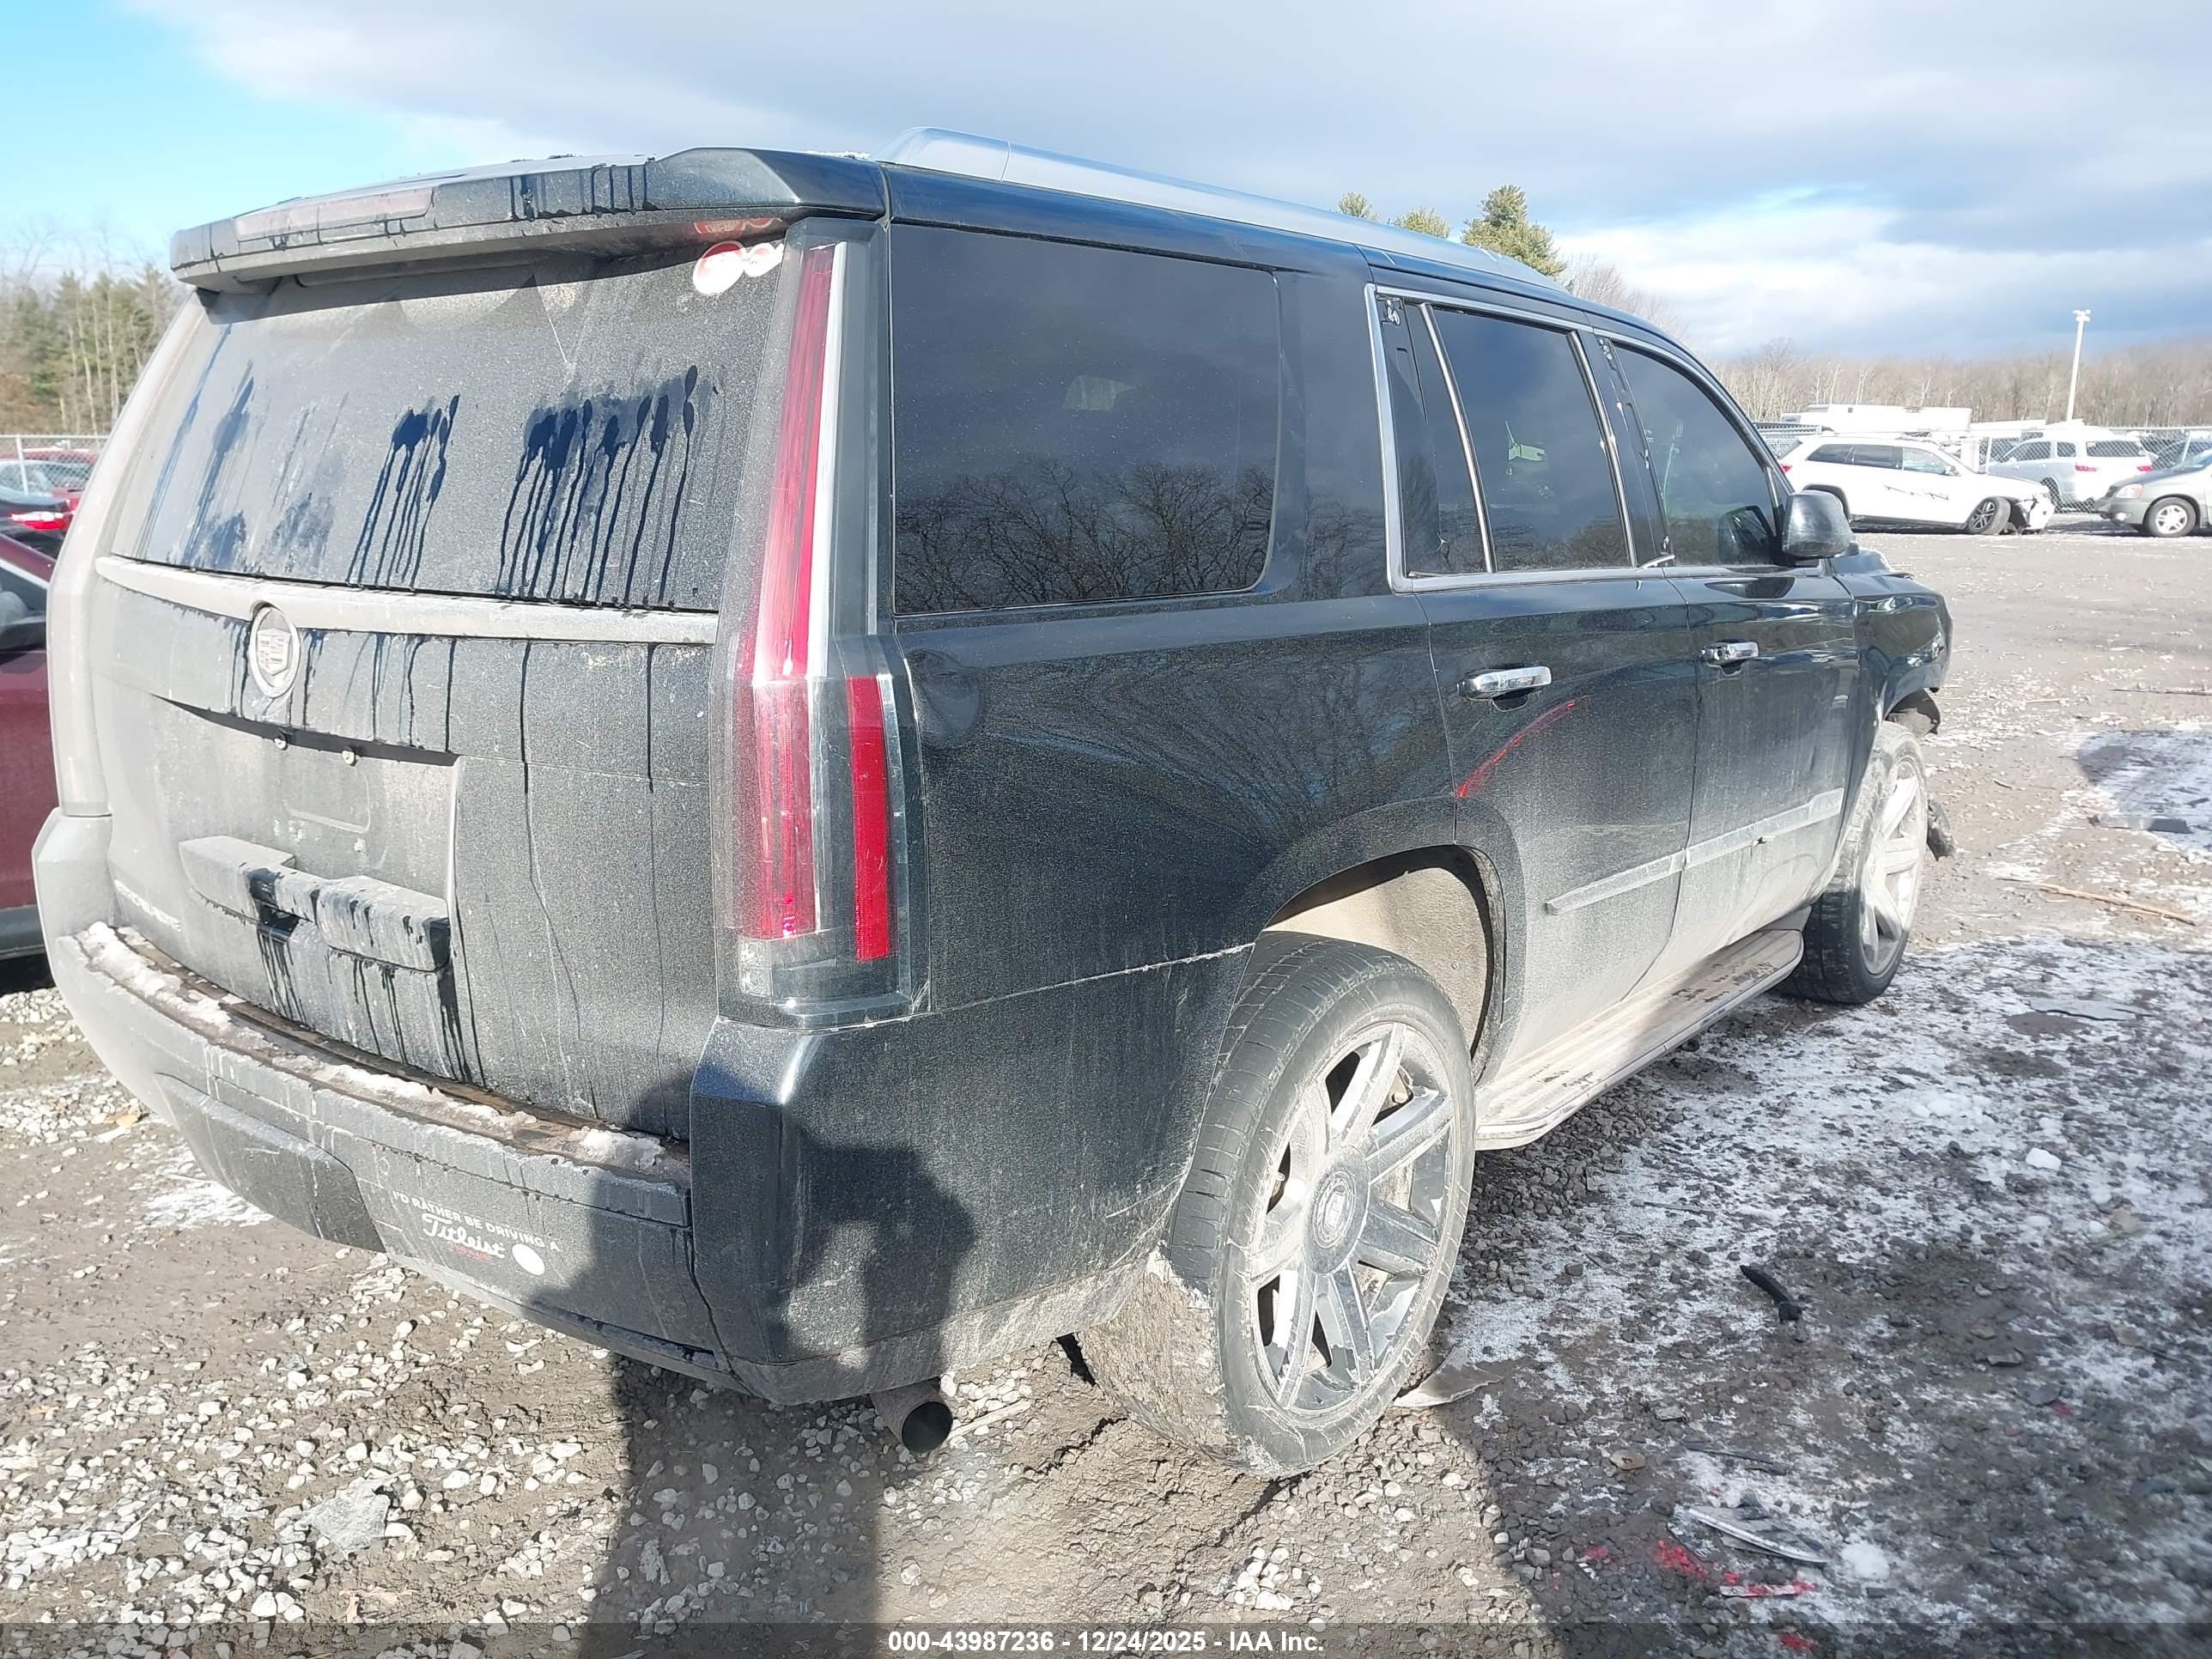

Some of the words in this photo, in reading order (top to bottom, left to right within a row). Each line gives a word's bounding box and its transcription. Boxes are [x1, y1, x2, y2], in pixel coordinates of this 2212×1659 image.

[392, 1190, 410, 1204] I'D
[411, 1196, 462, 1223] RATHER
[465, 1215, 483, 1230] BE
[484, 1222, 545, 1248] DRIVING
[550, 1242, 562, 1252] A
[421, 1212, 506, 1259] Titleist
